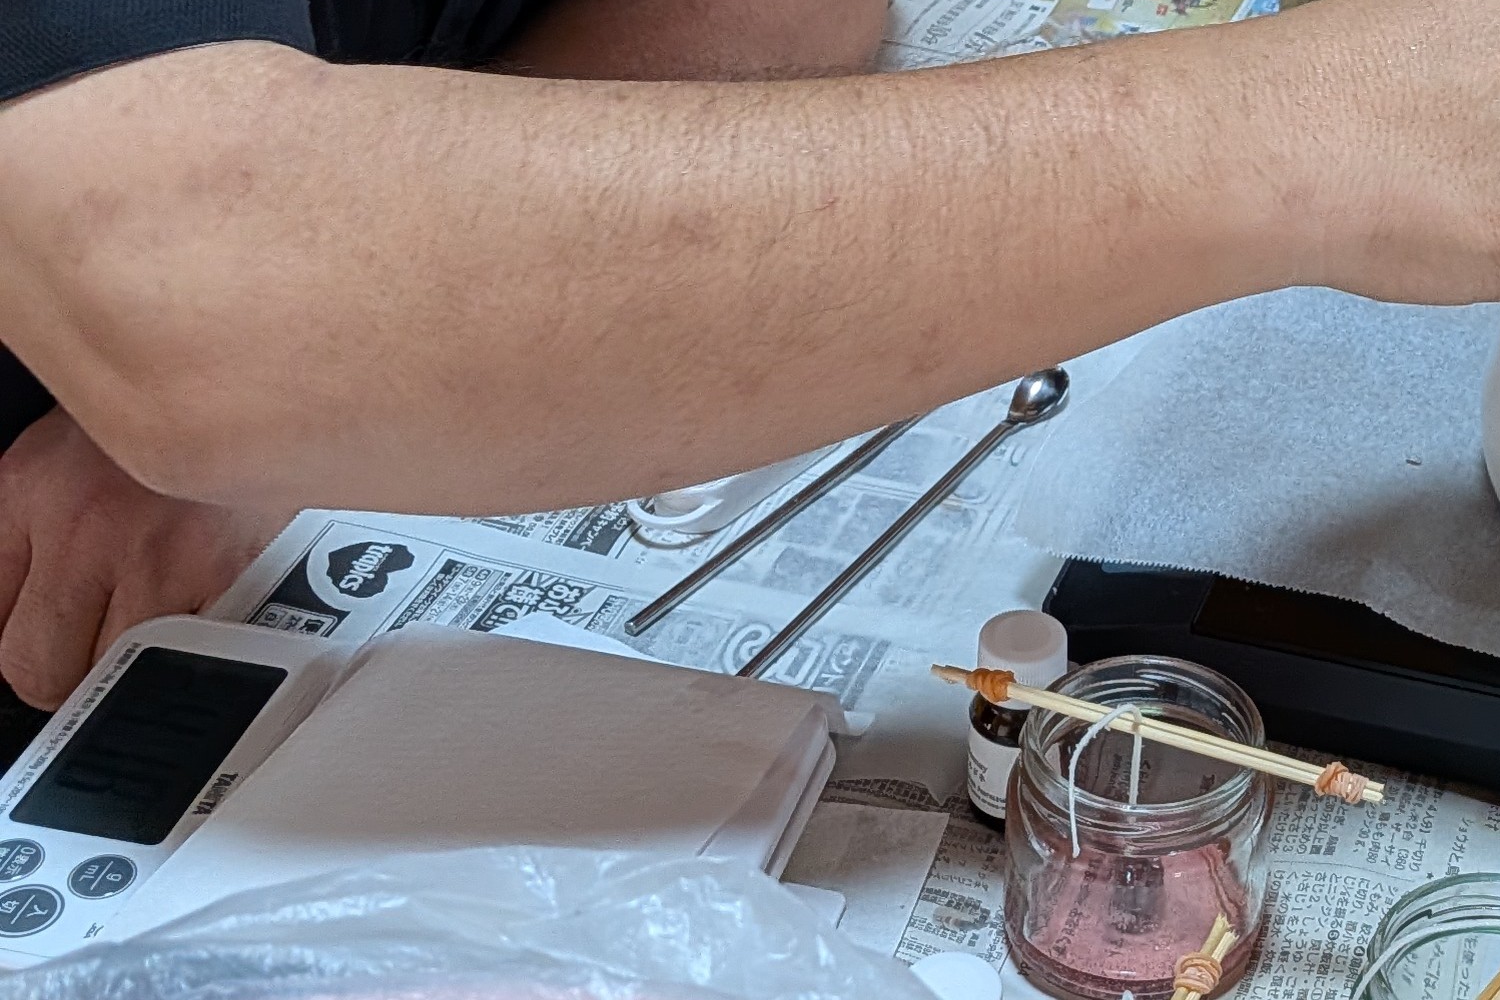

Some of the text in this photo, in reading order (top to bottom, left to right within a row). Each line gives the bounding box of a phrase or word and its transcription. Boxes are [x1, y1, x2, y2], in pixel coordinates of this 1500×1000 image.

[338, 544, 393, 591] trapics
[192, 773, 239, 815] TANITA
[79, 864, 99, 882] mL
[106, 873, 122, 882] g
